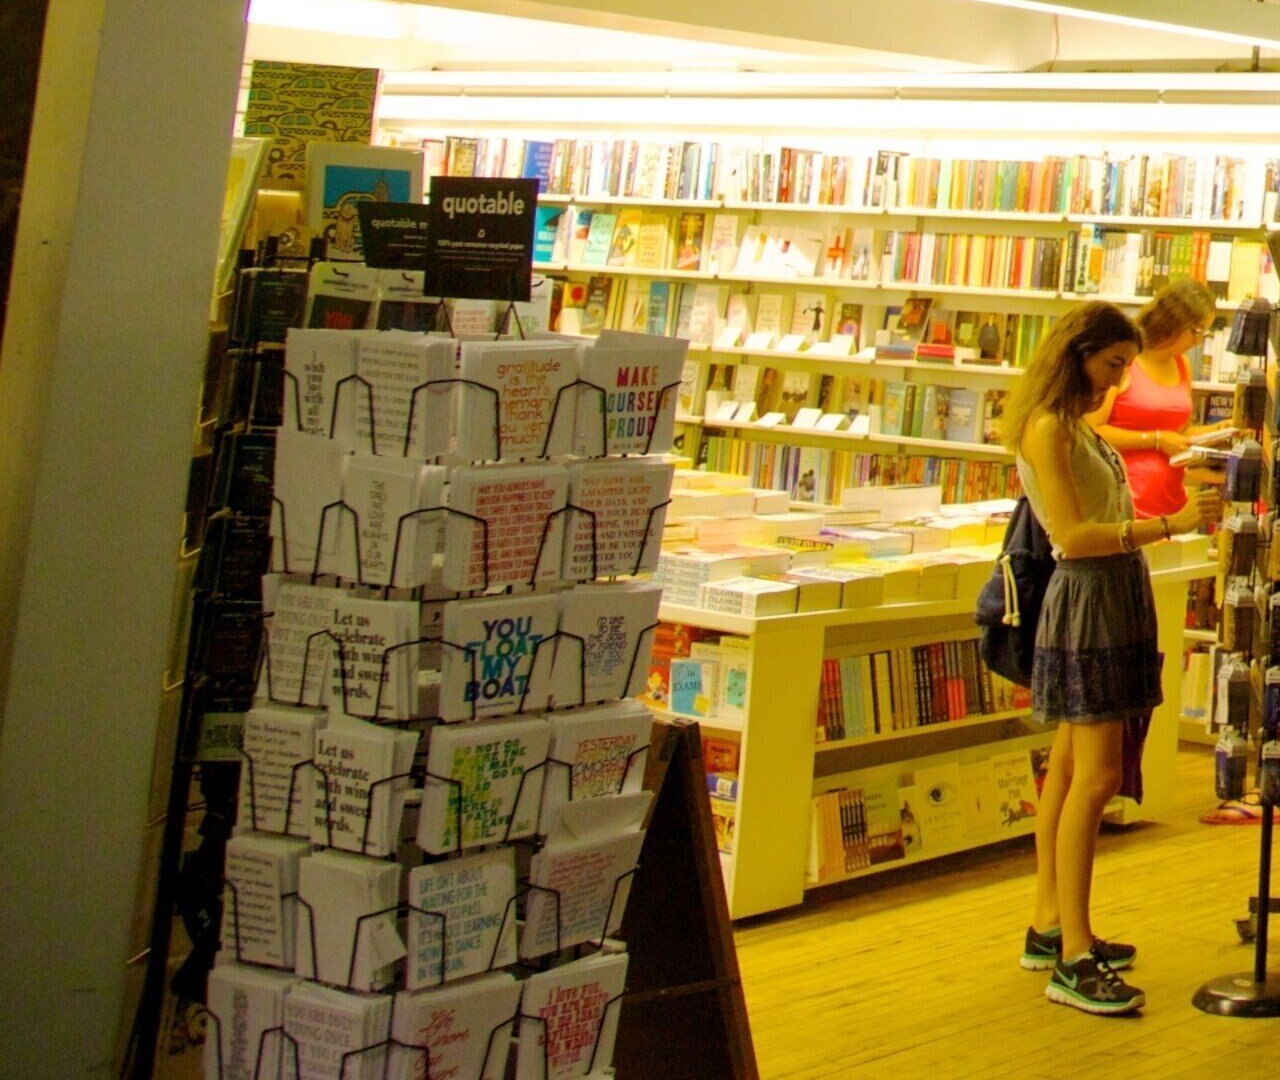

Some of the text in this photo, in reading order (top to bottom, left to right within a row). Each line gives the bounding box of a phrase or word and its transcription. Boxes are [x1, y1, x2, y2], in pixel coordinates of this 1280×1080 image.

[442, 191, 525, 219] quotable
[371, 218, 417, 230] quotable
[497, 358, 561, 379] gratitude
[509, 372, 548, 385] is the
[615, 366, 660, 388] MAKE
[505, 407, 543, 421] thank
[606, 416, 656, 439] PROUD
[333, 608, 370, 626] Let us
[482, 616, 533, 641] YOU
[332, 647, 359, 661] wth
[463, 634, 544, 662] FLOAT
[482, 656, 522, 680] MY
[332, 683, 372, 700] wrds.
[673, 680, 703, 691] EXAMS
[317, 739, 355, 759] Let us
[319, 759, 370, 781] elebrate
